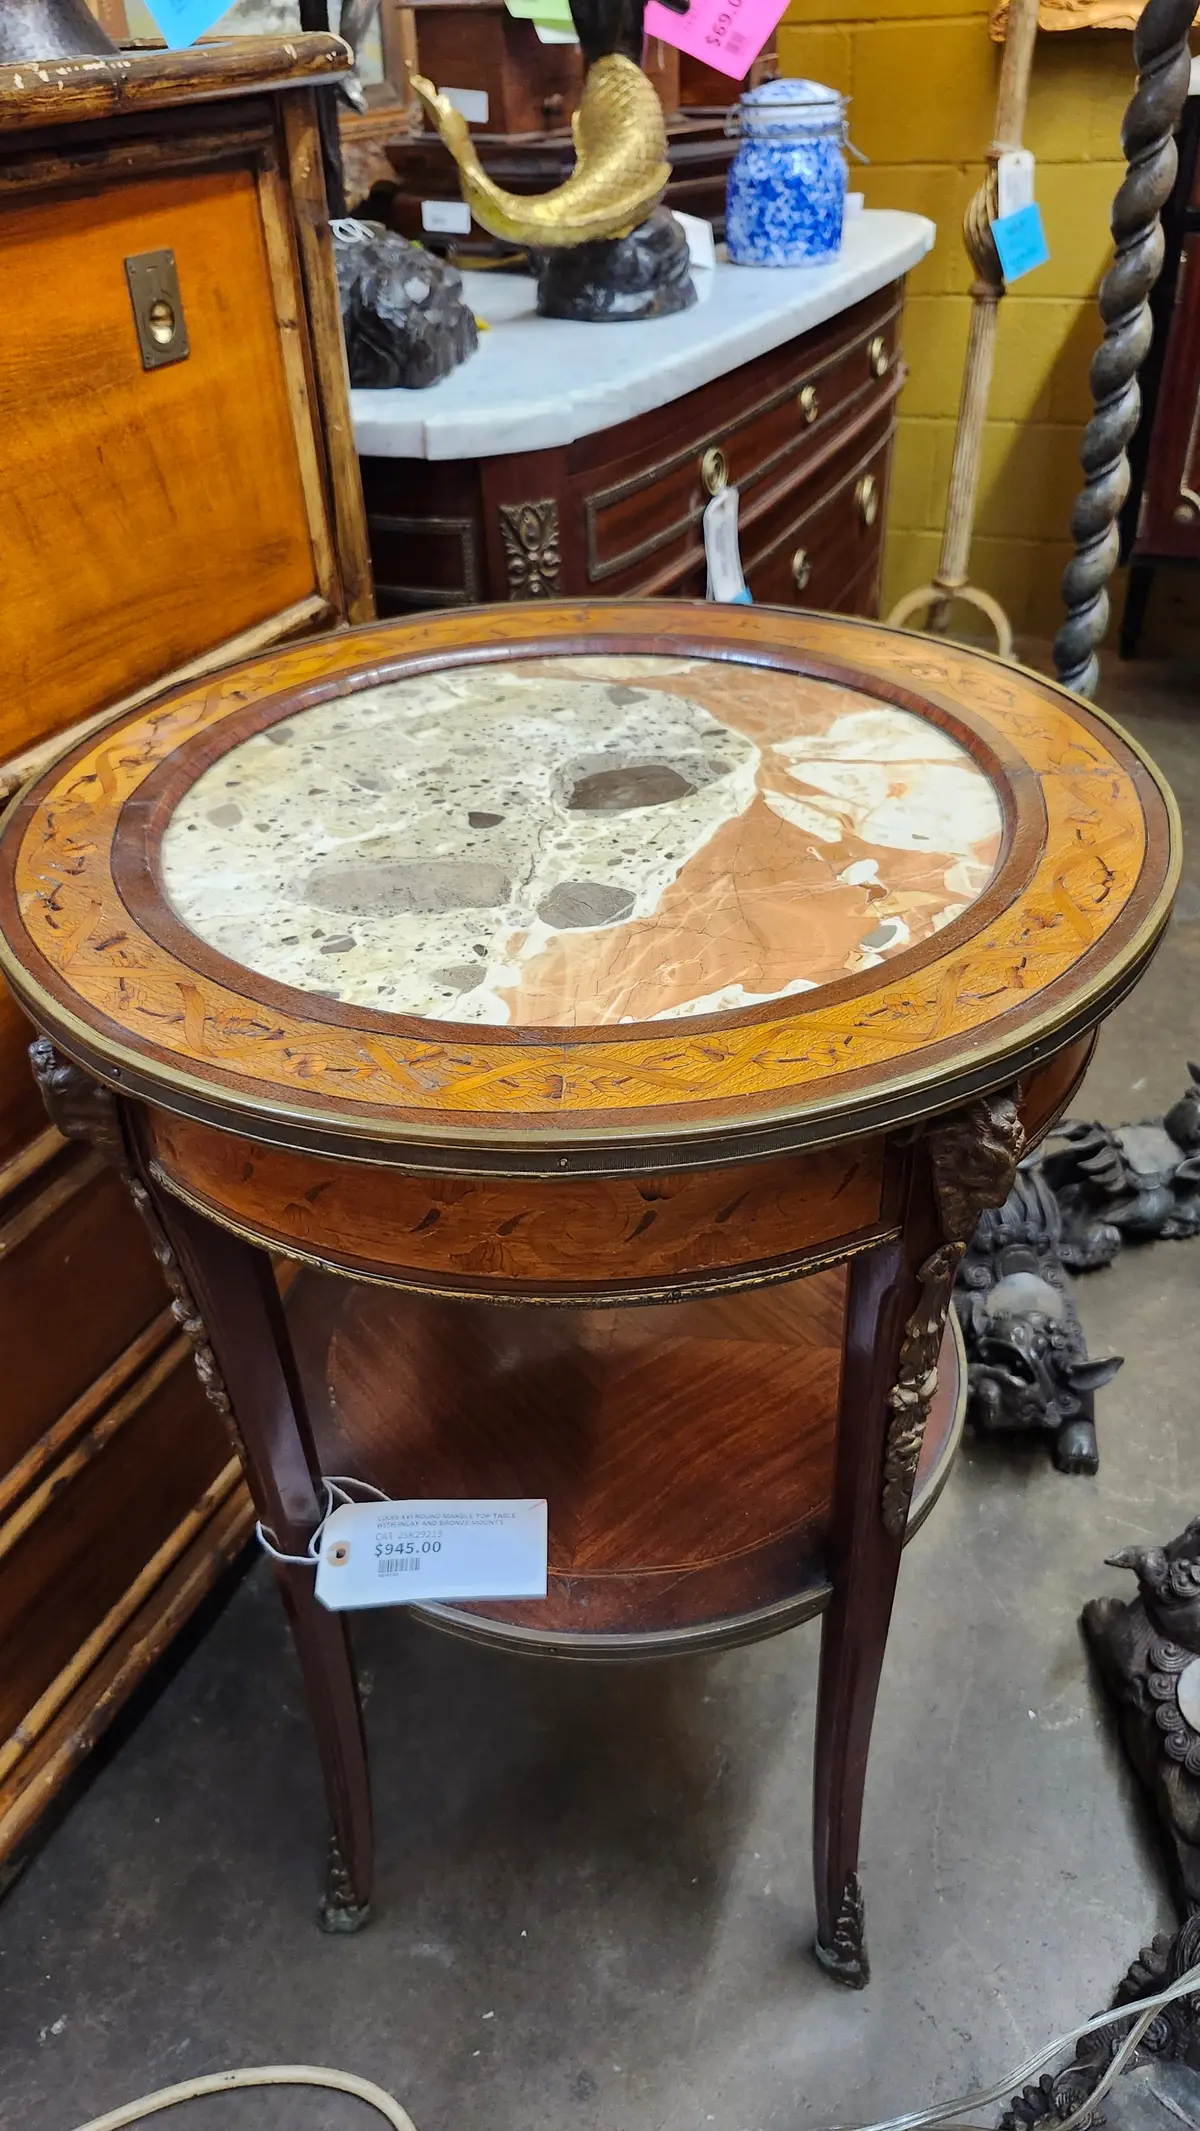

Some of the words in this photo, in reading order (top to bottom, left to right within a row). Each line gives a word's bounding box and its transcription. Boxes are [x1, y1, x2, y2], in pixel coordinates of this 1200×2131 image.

[378, 1514, 399, 1522] LOUIS
[442, 1512, 473, 1520] MARBLE
[377, 1521, 396, 1529] WITH
[397, 1520, 419, 1528] INLAY
[439, 1519, 469, 1527] BRONZE
[375, 1531, 393, 1541] CAT
[374, 1541, 442, 1558] $945.00
